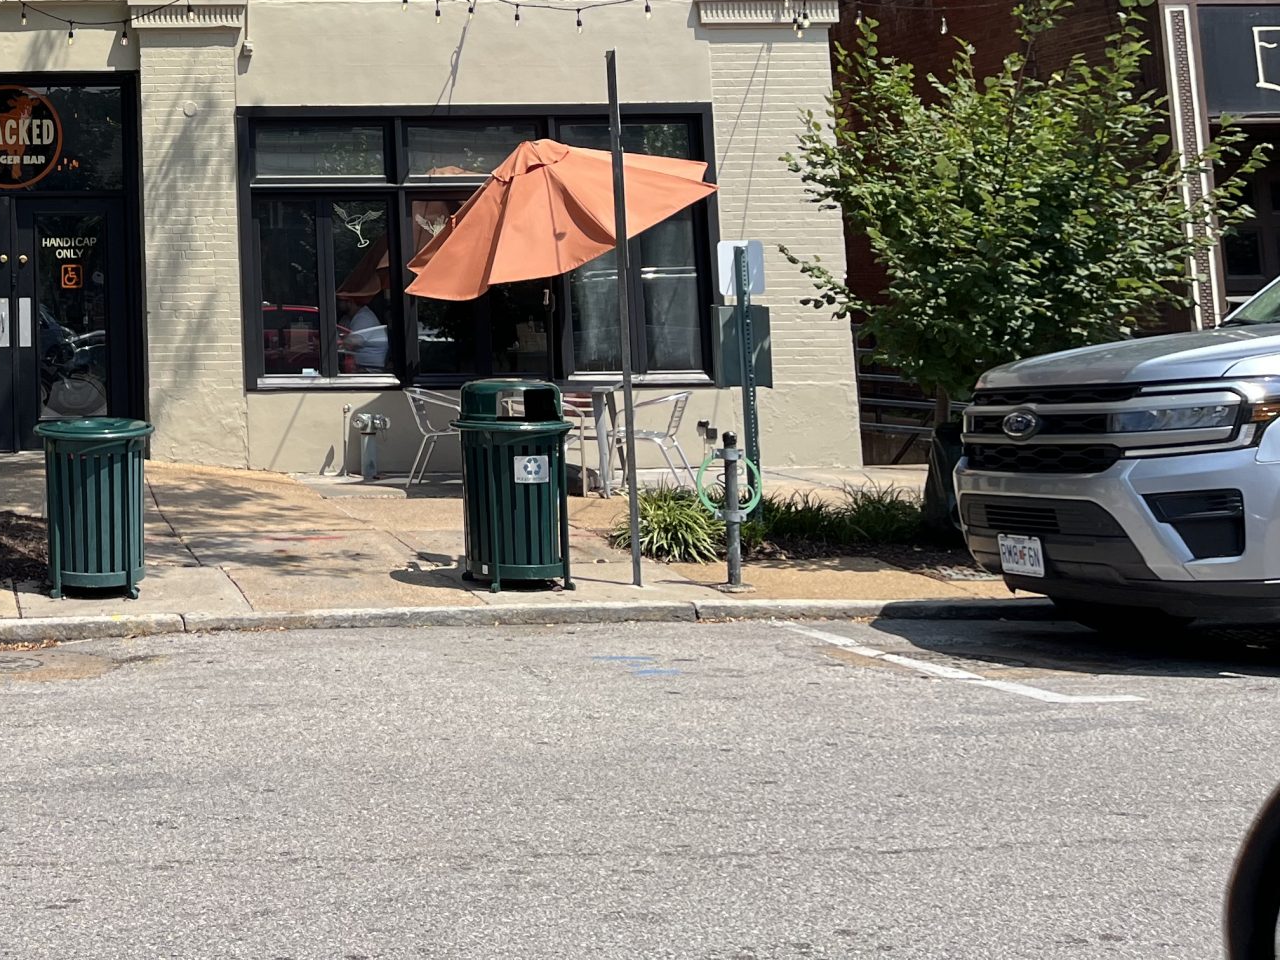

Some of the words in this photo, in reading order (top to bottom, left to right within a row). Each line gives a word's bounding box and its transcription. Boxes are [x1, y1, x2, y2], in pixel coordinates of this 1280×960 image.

[23, 155, 46, 165] BAR
[42, 237, 97, 247] HANDICAP
[55, 248, 84, 259] ONLY
